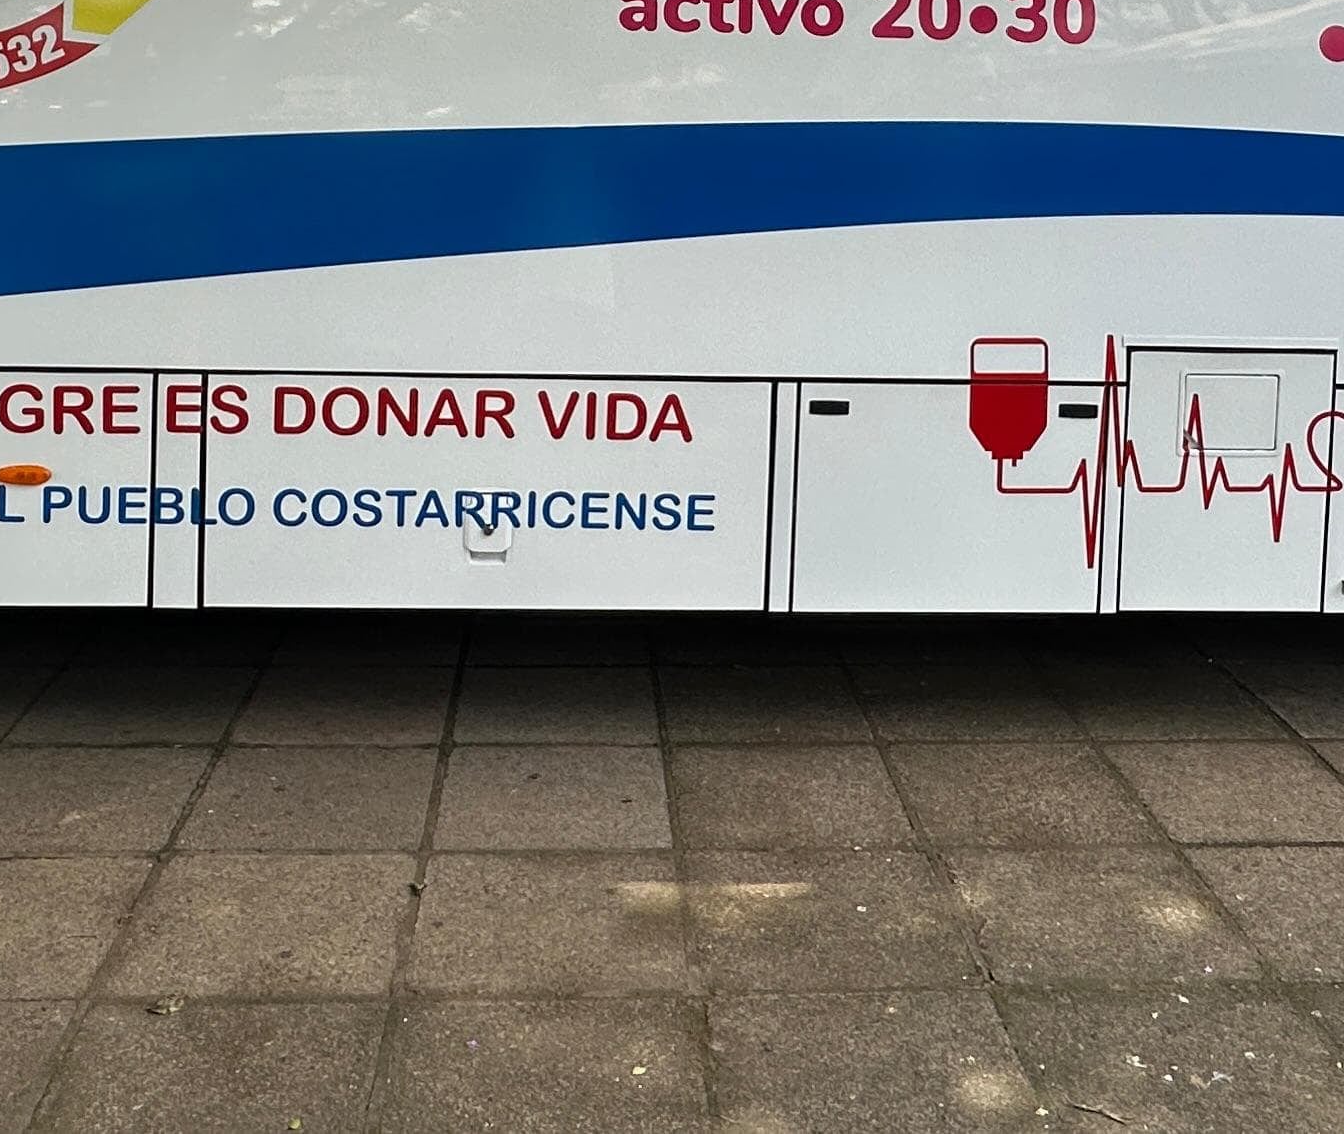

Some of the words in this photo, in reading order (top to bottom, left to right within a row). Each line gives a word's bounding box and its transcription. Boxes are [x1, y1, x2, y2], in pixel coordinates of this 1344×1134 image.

[165, 385, 249, 435] ES
[273, 387, 515, 439] DONAR
[538, 390, 693, 443] VIDA
[42, 484, 255, 526] PUEBLO
[272, 487, 716, 532] COSTARRICENSE
